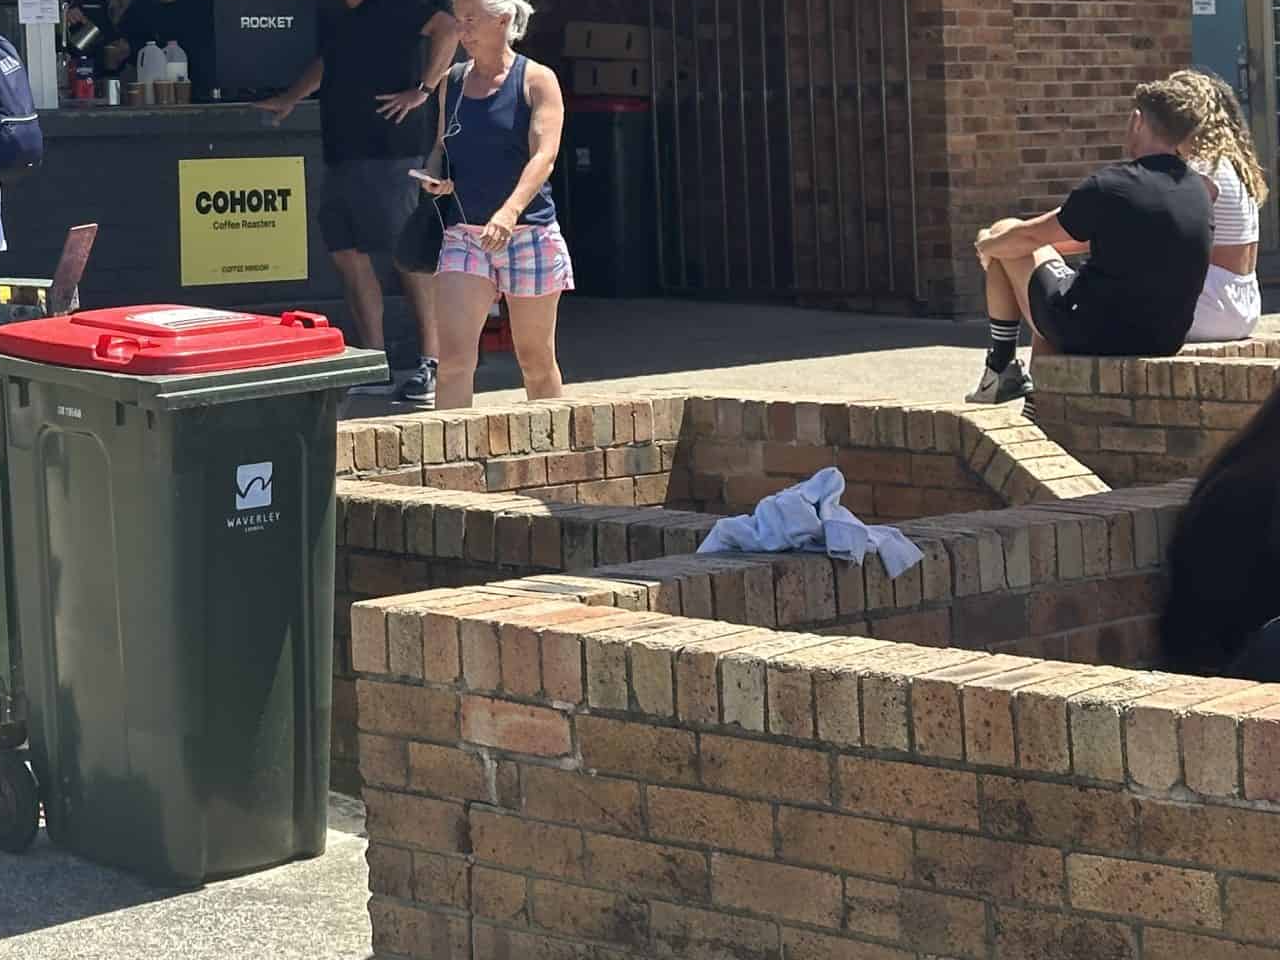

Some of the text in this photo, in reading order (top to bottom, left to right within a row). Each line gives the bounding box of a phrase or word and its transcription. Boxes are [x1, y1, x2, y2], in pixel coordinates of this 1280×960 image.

[240, 16, 295, 29] ROCKET
[195, 188, 292, 215] COHORT
[212, 219, 276, 231] Coffee Roasters
[226, 511, 281, 528] WAVERLEY
